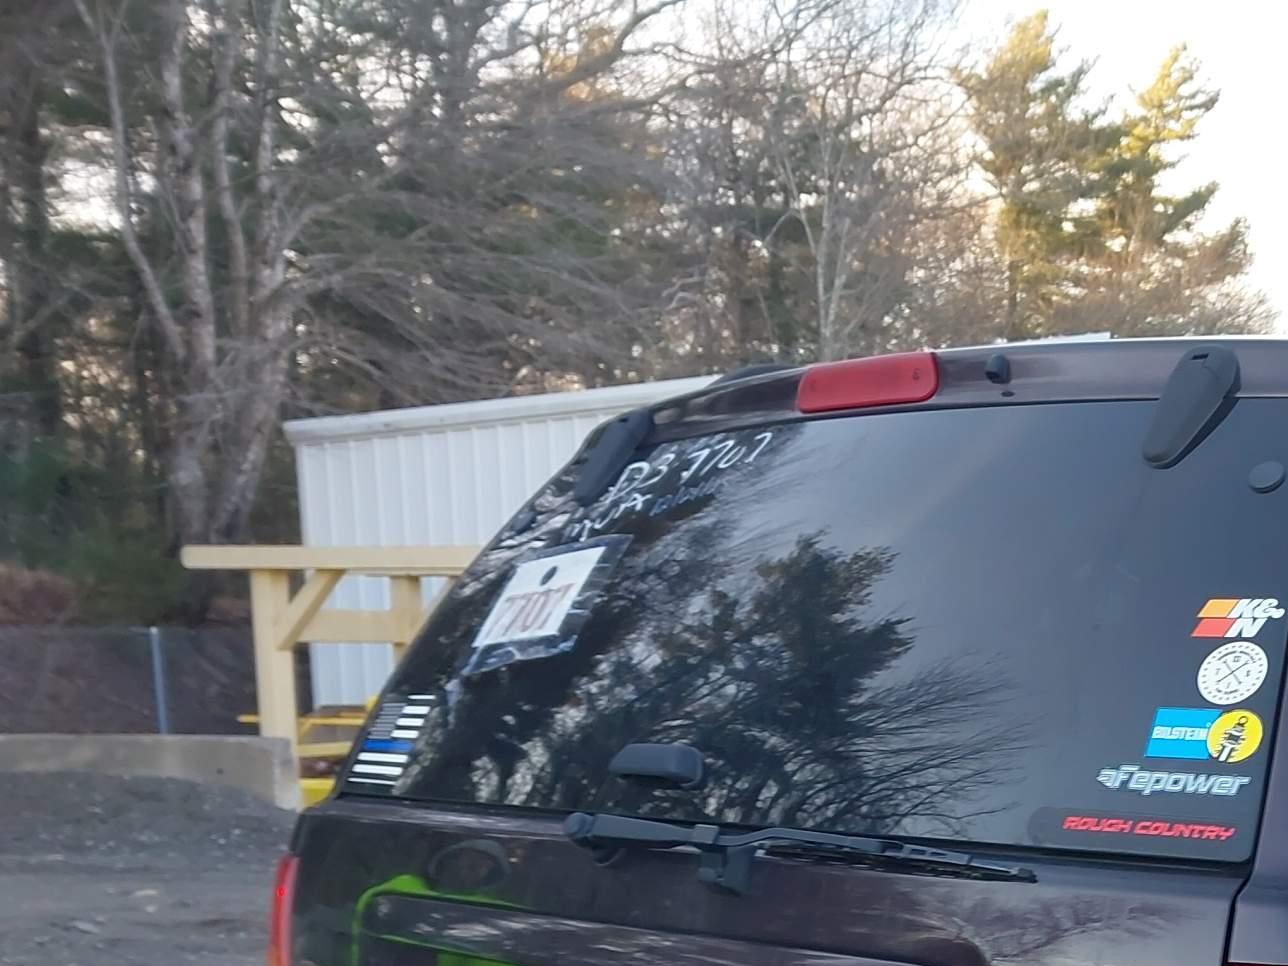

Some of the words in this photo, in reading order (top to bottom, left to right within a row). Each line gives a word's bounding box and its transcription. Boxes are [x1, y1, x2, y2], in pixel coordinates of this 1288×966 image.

[1151, 725, 1209, 741] BILSTEIN
[1062, 816, 1133, 833] ROUGH
[1134, 819, 1237, 842] COUNTRY
